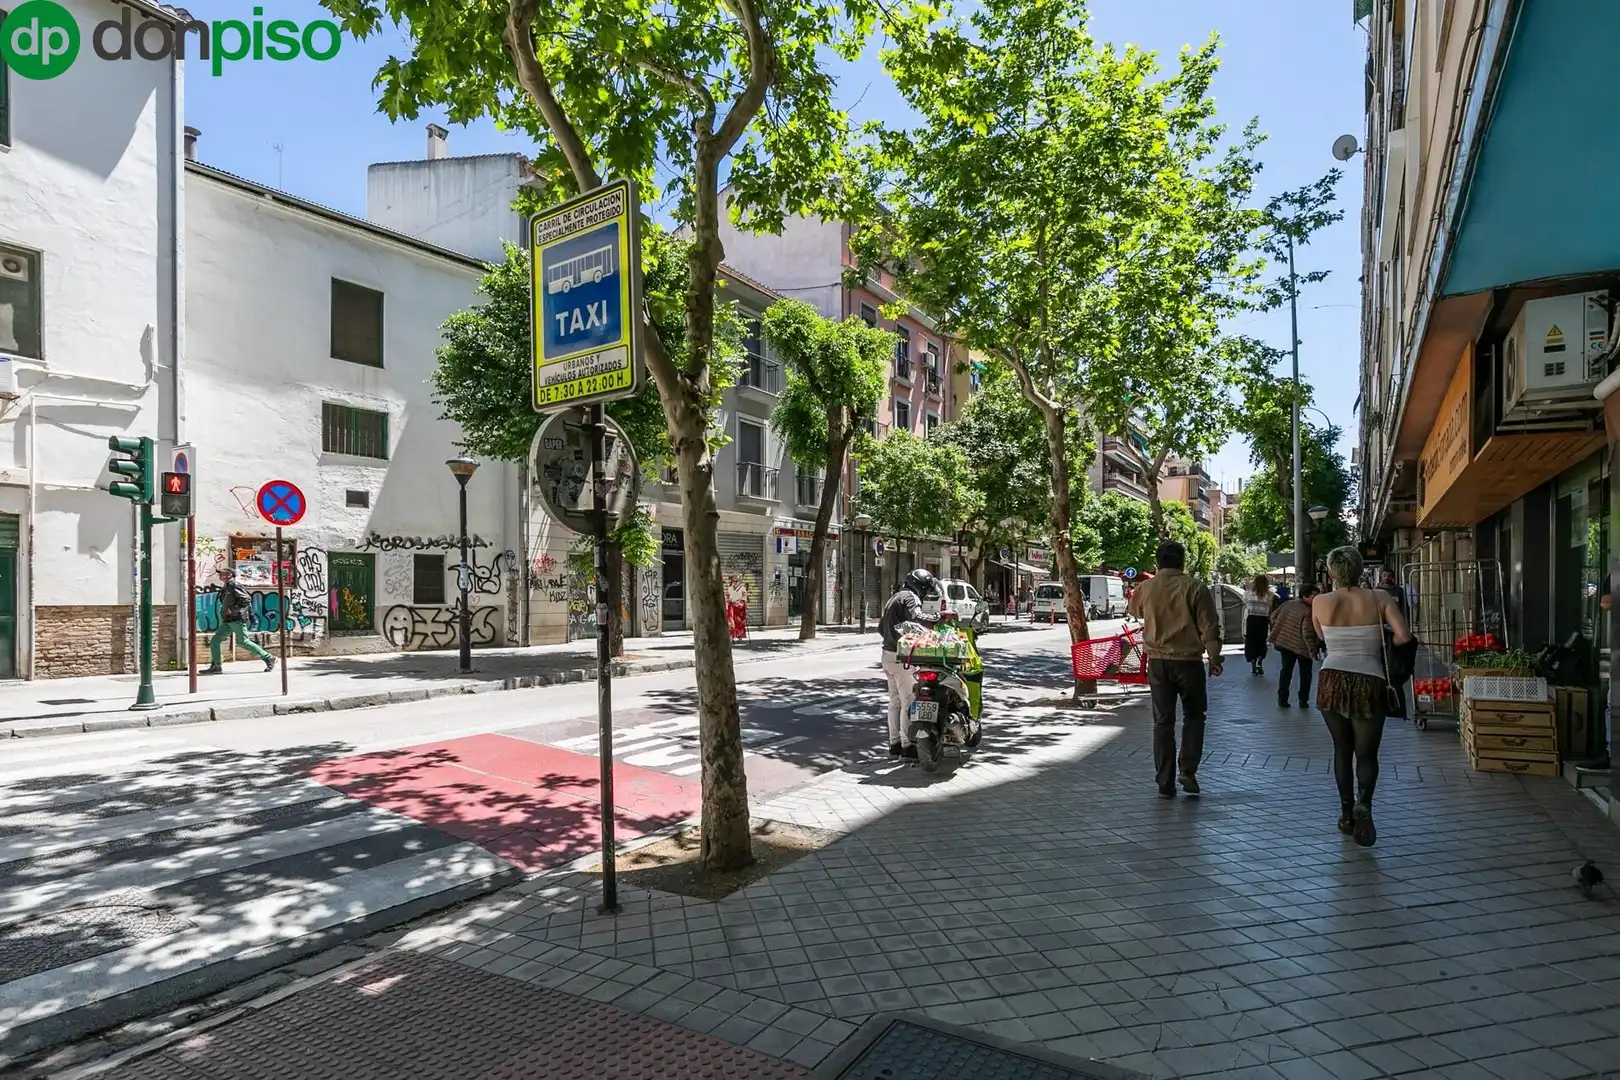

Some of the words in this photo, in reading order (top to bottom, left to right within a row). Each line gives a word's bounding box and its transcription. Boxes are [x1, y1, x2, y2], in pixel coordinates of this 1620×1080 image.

[538, 216, 562, 233] CARRIL
[562, 212, 572, 223] DE
[538, 219, 584, 244] ESPECIALMENTE
[586, 204, 621, 225] PROTEGIDO
[555, 300, 607, 337] TAXI
[563, 355, 595, 371] URBANOS
[595, 353, 600, 364] Y
[578, 360, 622, 377] AUTORIZADOS
[540, 388, 551, 402] DE
[554, 384, 574, 400] 7:30
[577, 381, 584, 395] A
[587, 375, 614, 393] 22:00
